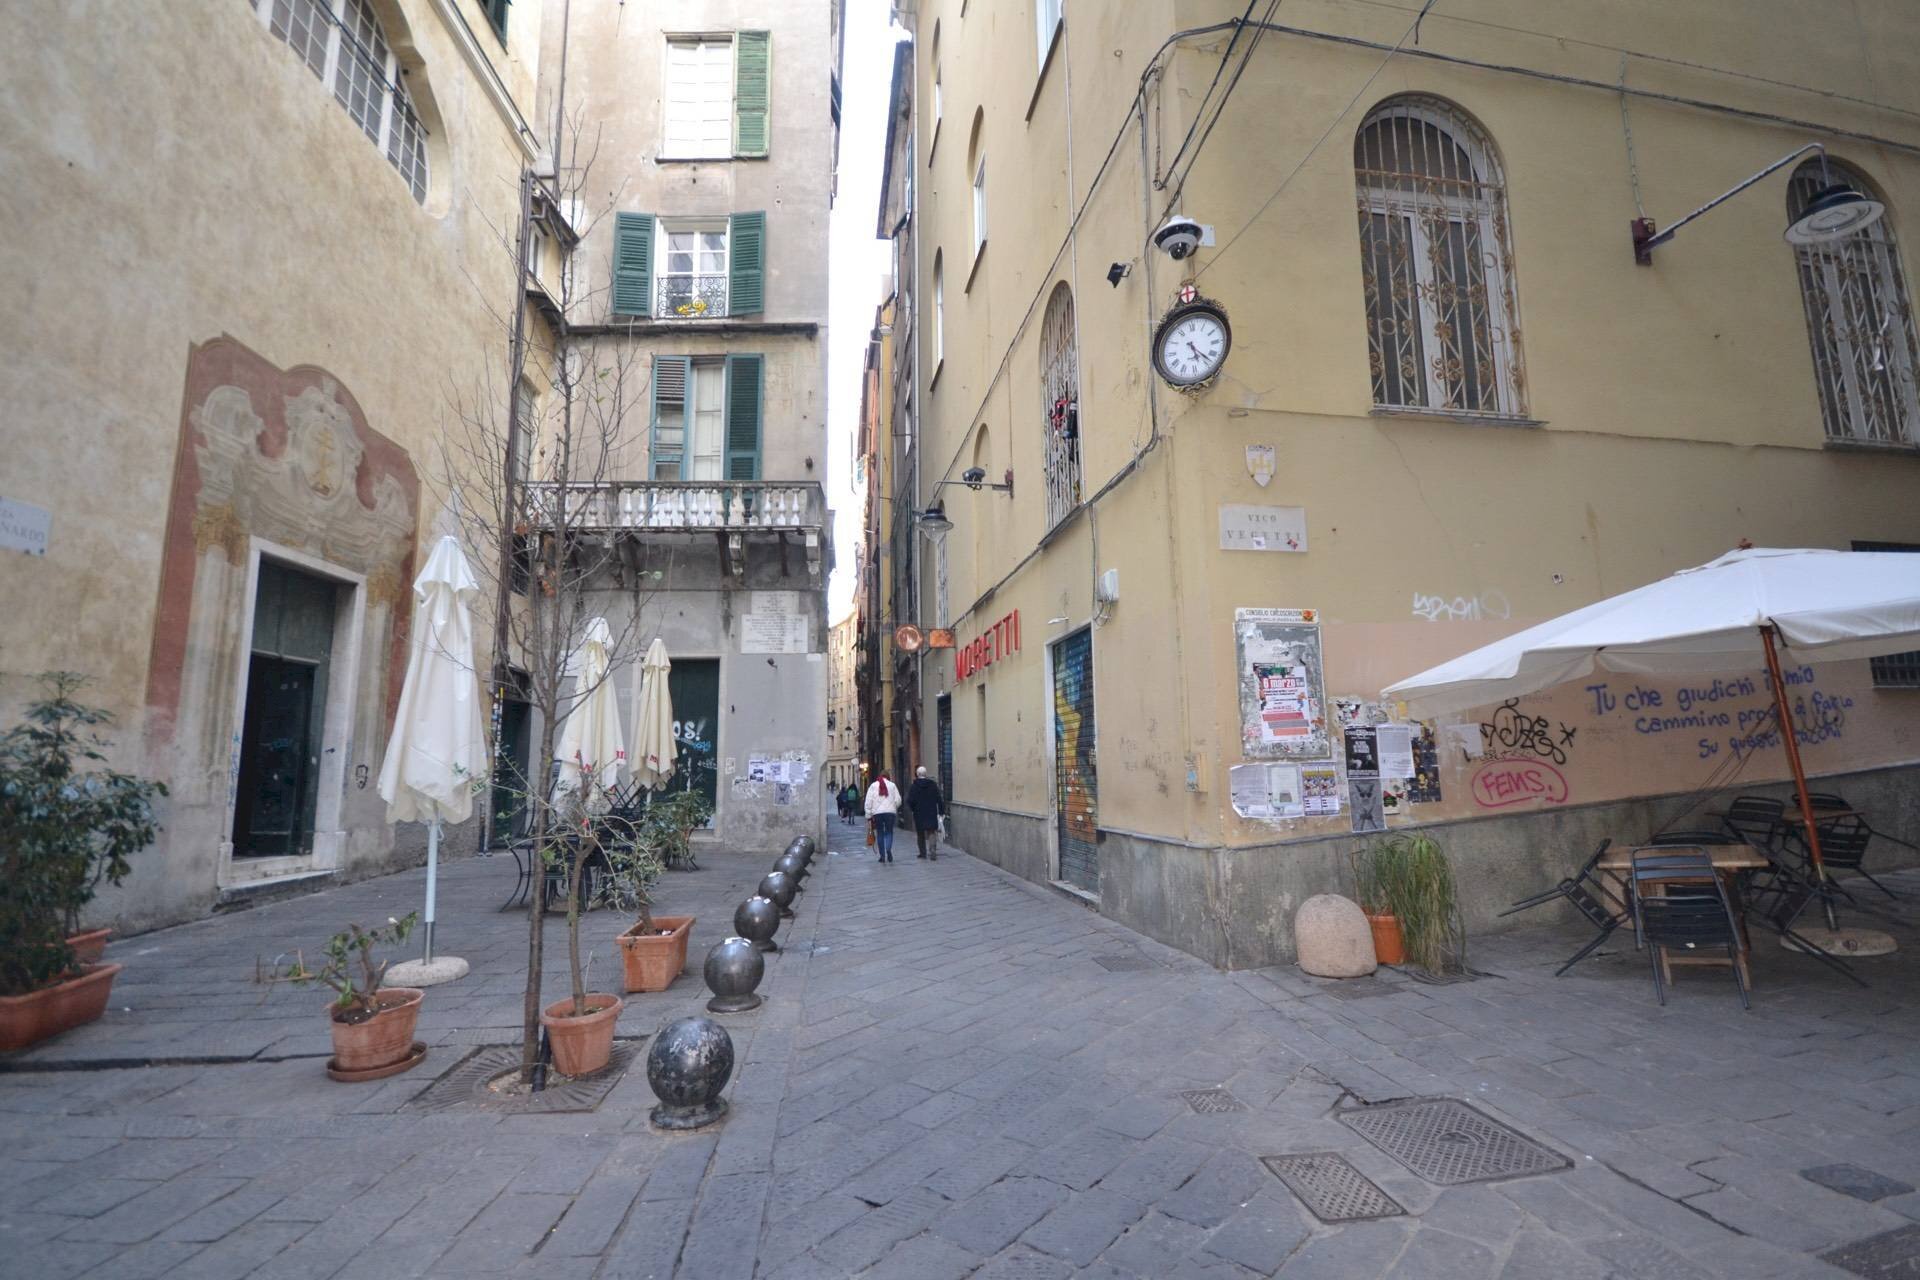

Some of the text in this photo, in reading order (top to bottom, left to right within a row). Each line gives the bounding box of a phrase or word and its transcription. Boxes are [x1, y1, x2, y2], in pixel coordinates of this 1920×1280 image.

[1248, 514, 1277, 522] VICO
[956, 607, 1019, 681] MORETTI
[1586, 684, 1616, 715] Tu
[1625, 685, 1663, 711] che
[1678, 677, 1756, 712] giudichi
[1784, 666, 1814, 685] mio
[1635, 711, 1729, 733] cammino
[1699, 738, 1719, 758] Su
